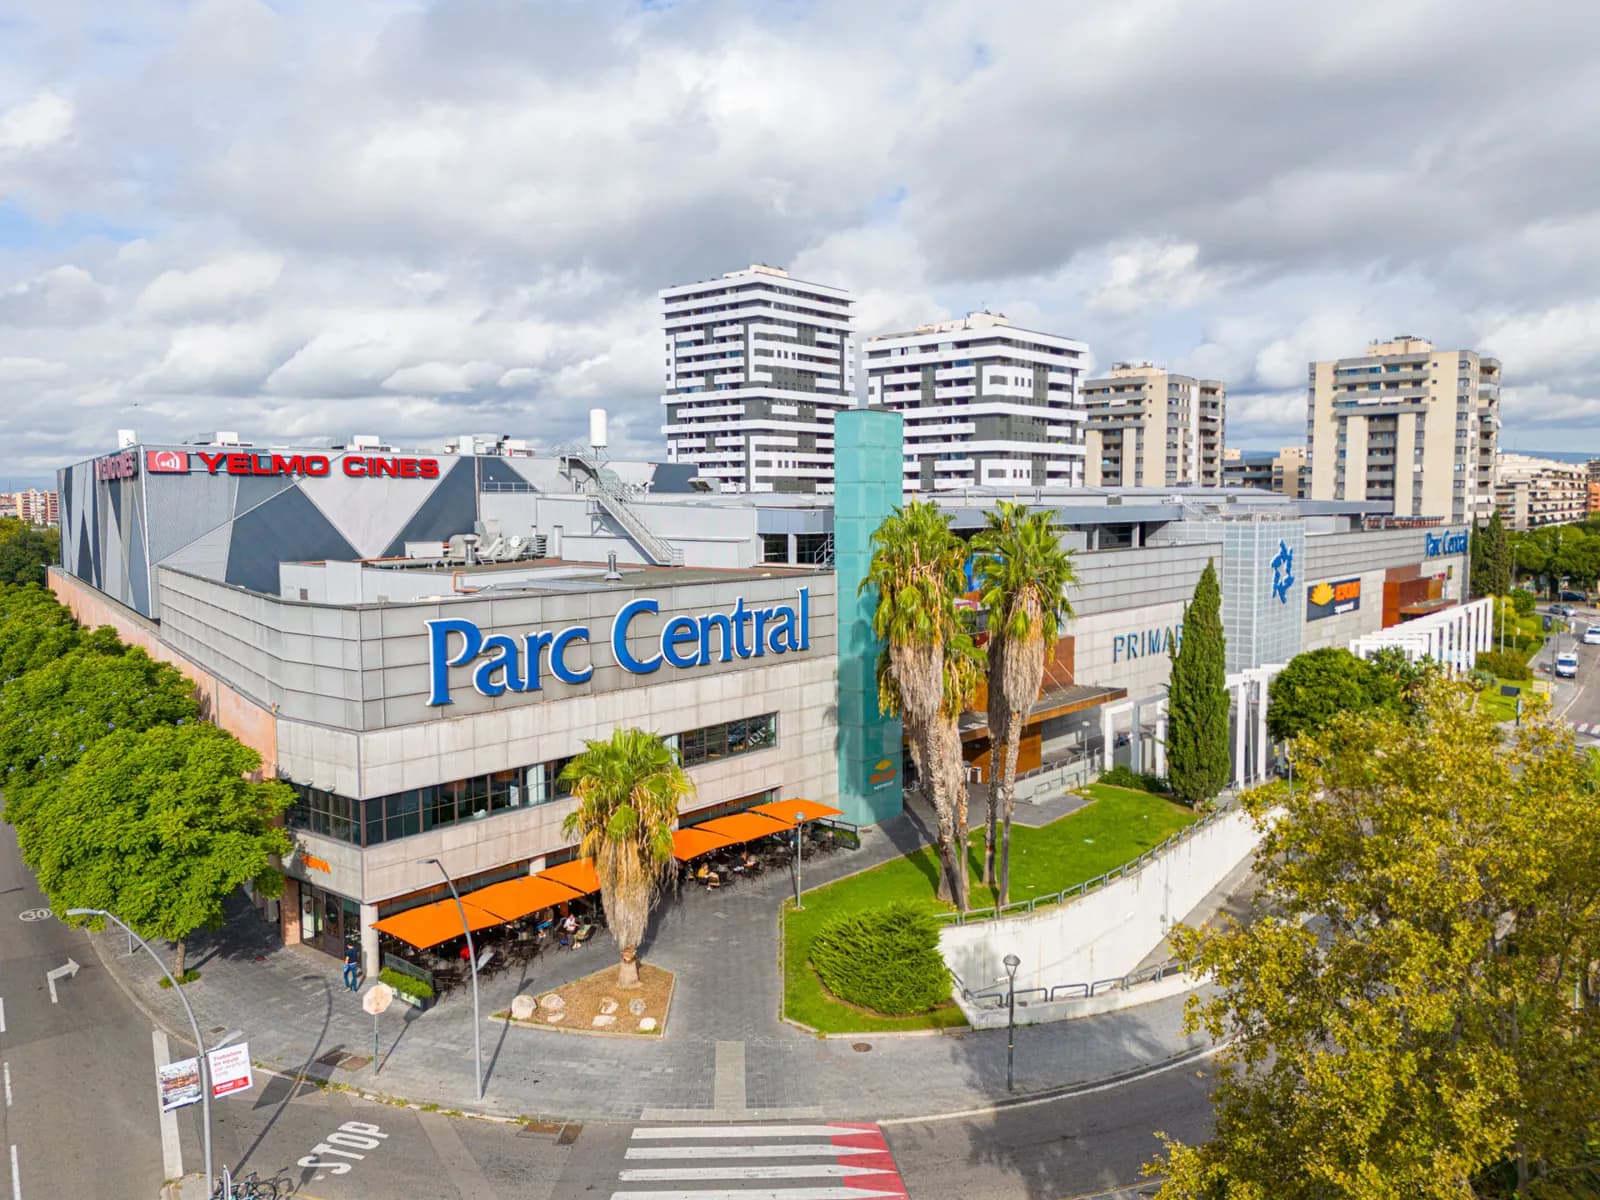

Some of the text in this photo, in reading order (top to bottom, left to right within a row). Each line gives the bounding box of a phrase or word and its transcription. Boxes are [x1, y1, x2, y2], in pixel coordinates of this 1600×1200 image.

[198, 451, 440, 478] YELMO CINES
[424, 586, 811, 706] Parc Central
[1113, 624, 1184, 664] PRIMAR
[297, 1121, 389, 1175] STOP
